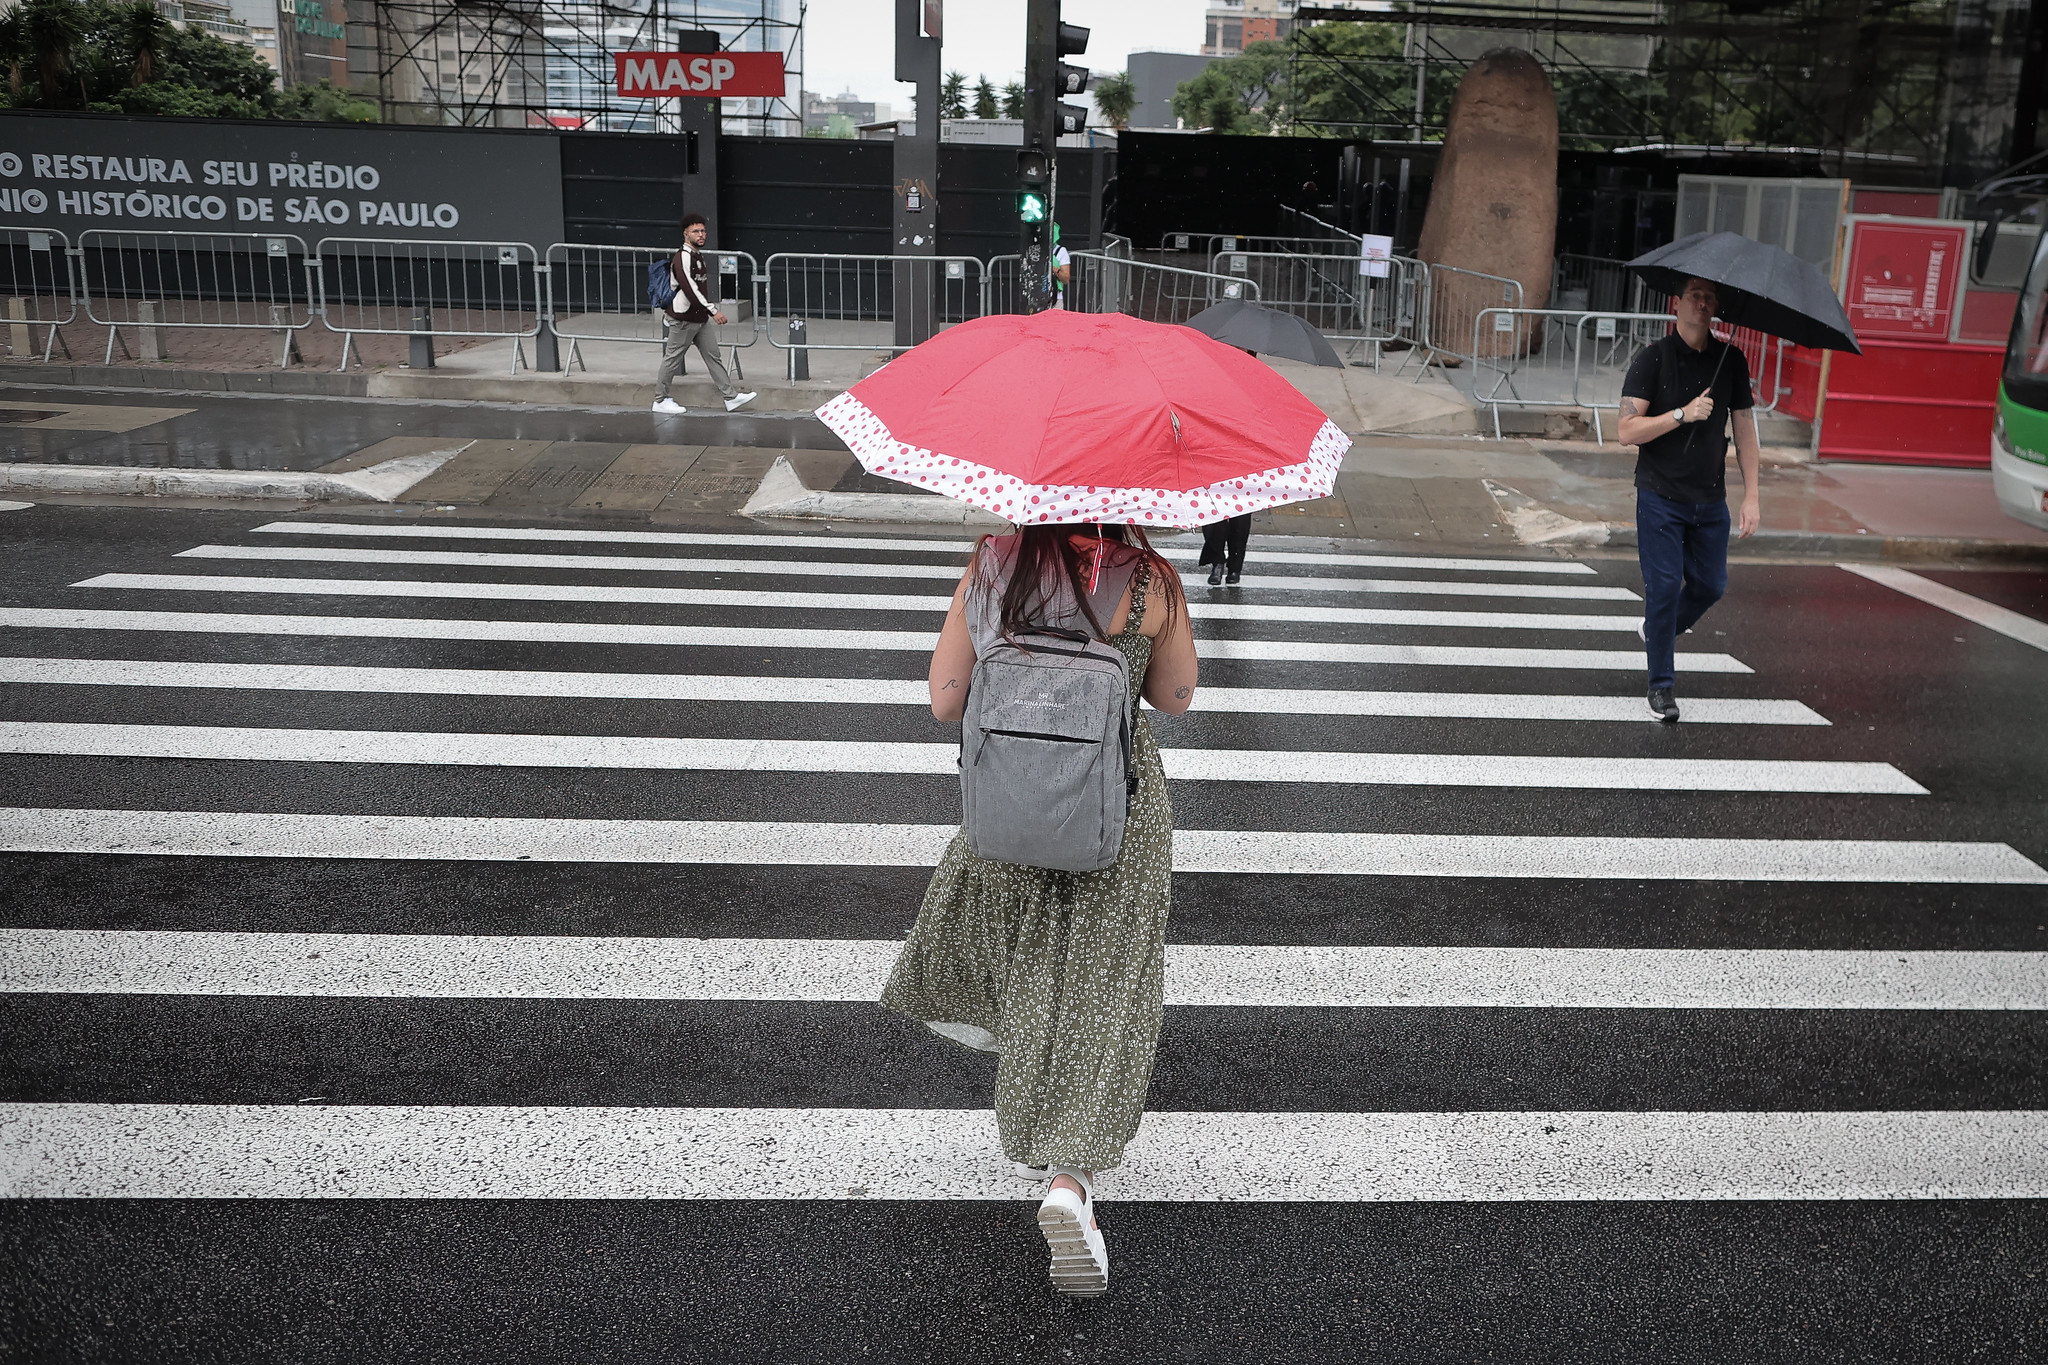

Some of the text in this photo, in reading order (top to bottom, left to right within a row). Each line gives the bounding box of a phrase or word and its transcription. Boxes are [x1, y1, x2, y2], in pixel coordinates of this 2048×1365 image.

[623, 58, 735, 91] MASP
[32, 153, 193, 183] RESTAURA
[202, 160, 259, 187] SEU
[268, 161, 380, 190] PRÉDIO
[57, 190, 226, 220] HISTÓRICO
[236, 197, 275, 222] DE
[284, 196, 351, 225] SÃO
[358, 201, 460, 229] PAULO
